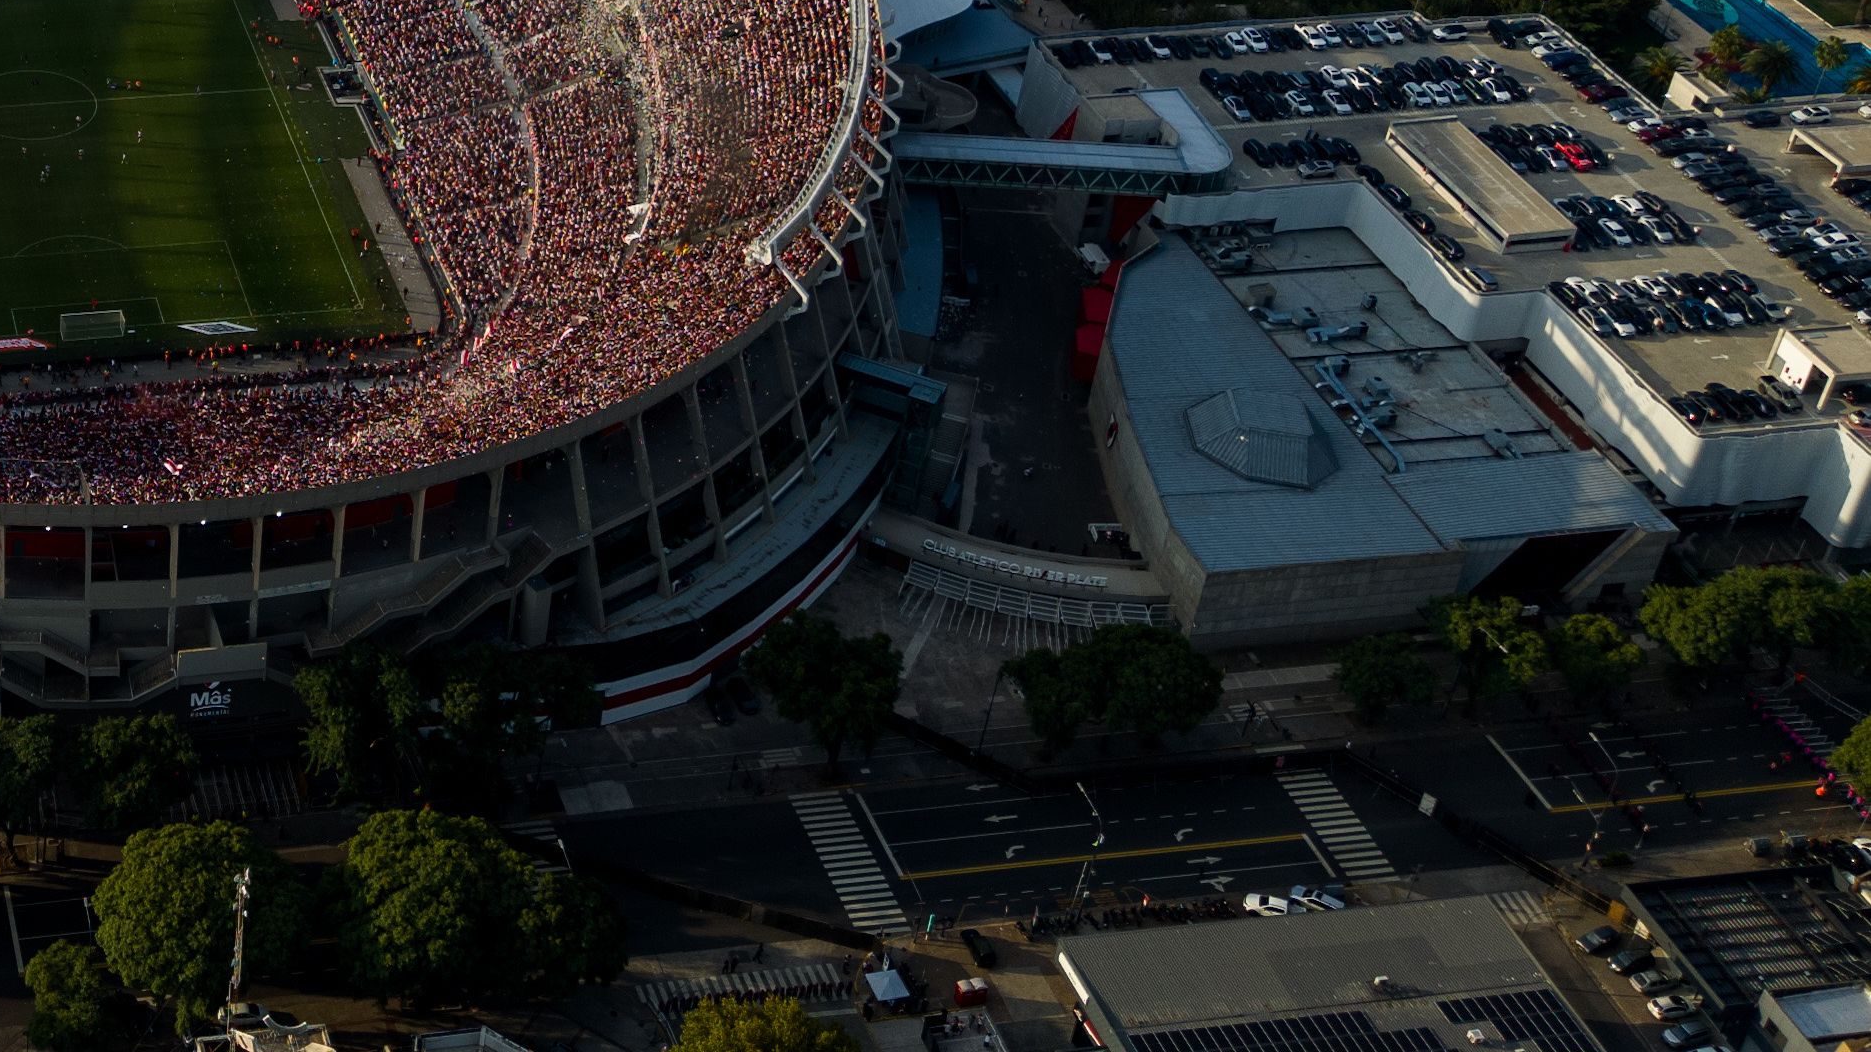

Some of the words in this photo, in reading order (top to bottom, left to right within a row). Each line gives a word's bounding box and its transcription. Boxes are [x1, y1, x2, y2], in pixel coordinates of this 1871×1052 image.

[922, 538, 956, 557] CLUB
[957, 551, 1020, 574] ATLETICO
[1023, 565, 1064, 582] RIVER
[1067, 573, 1108, 587] PLATE
